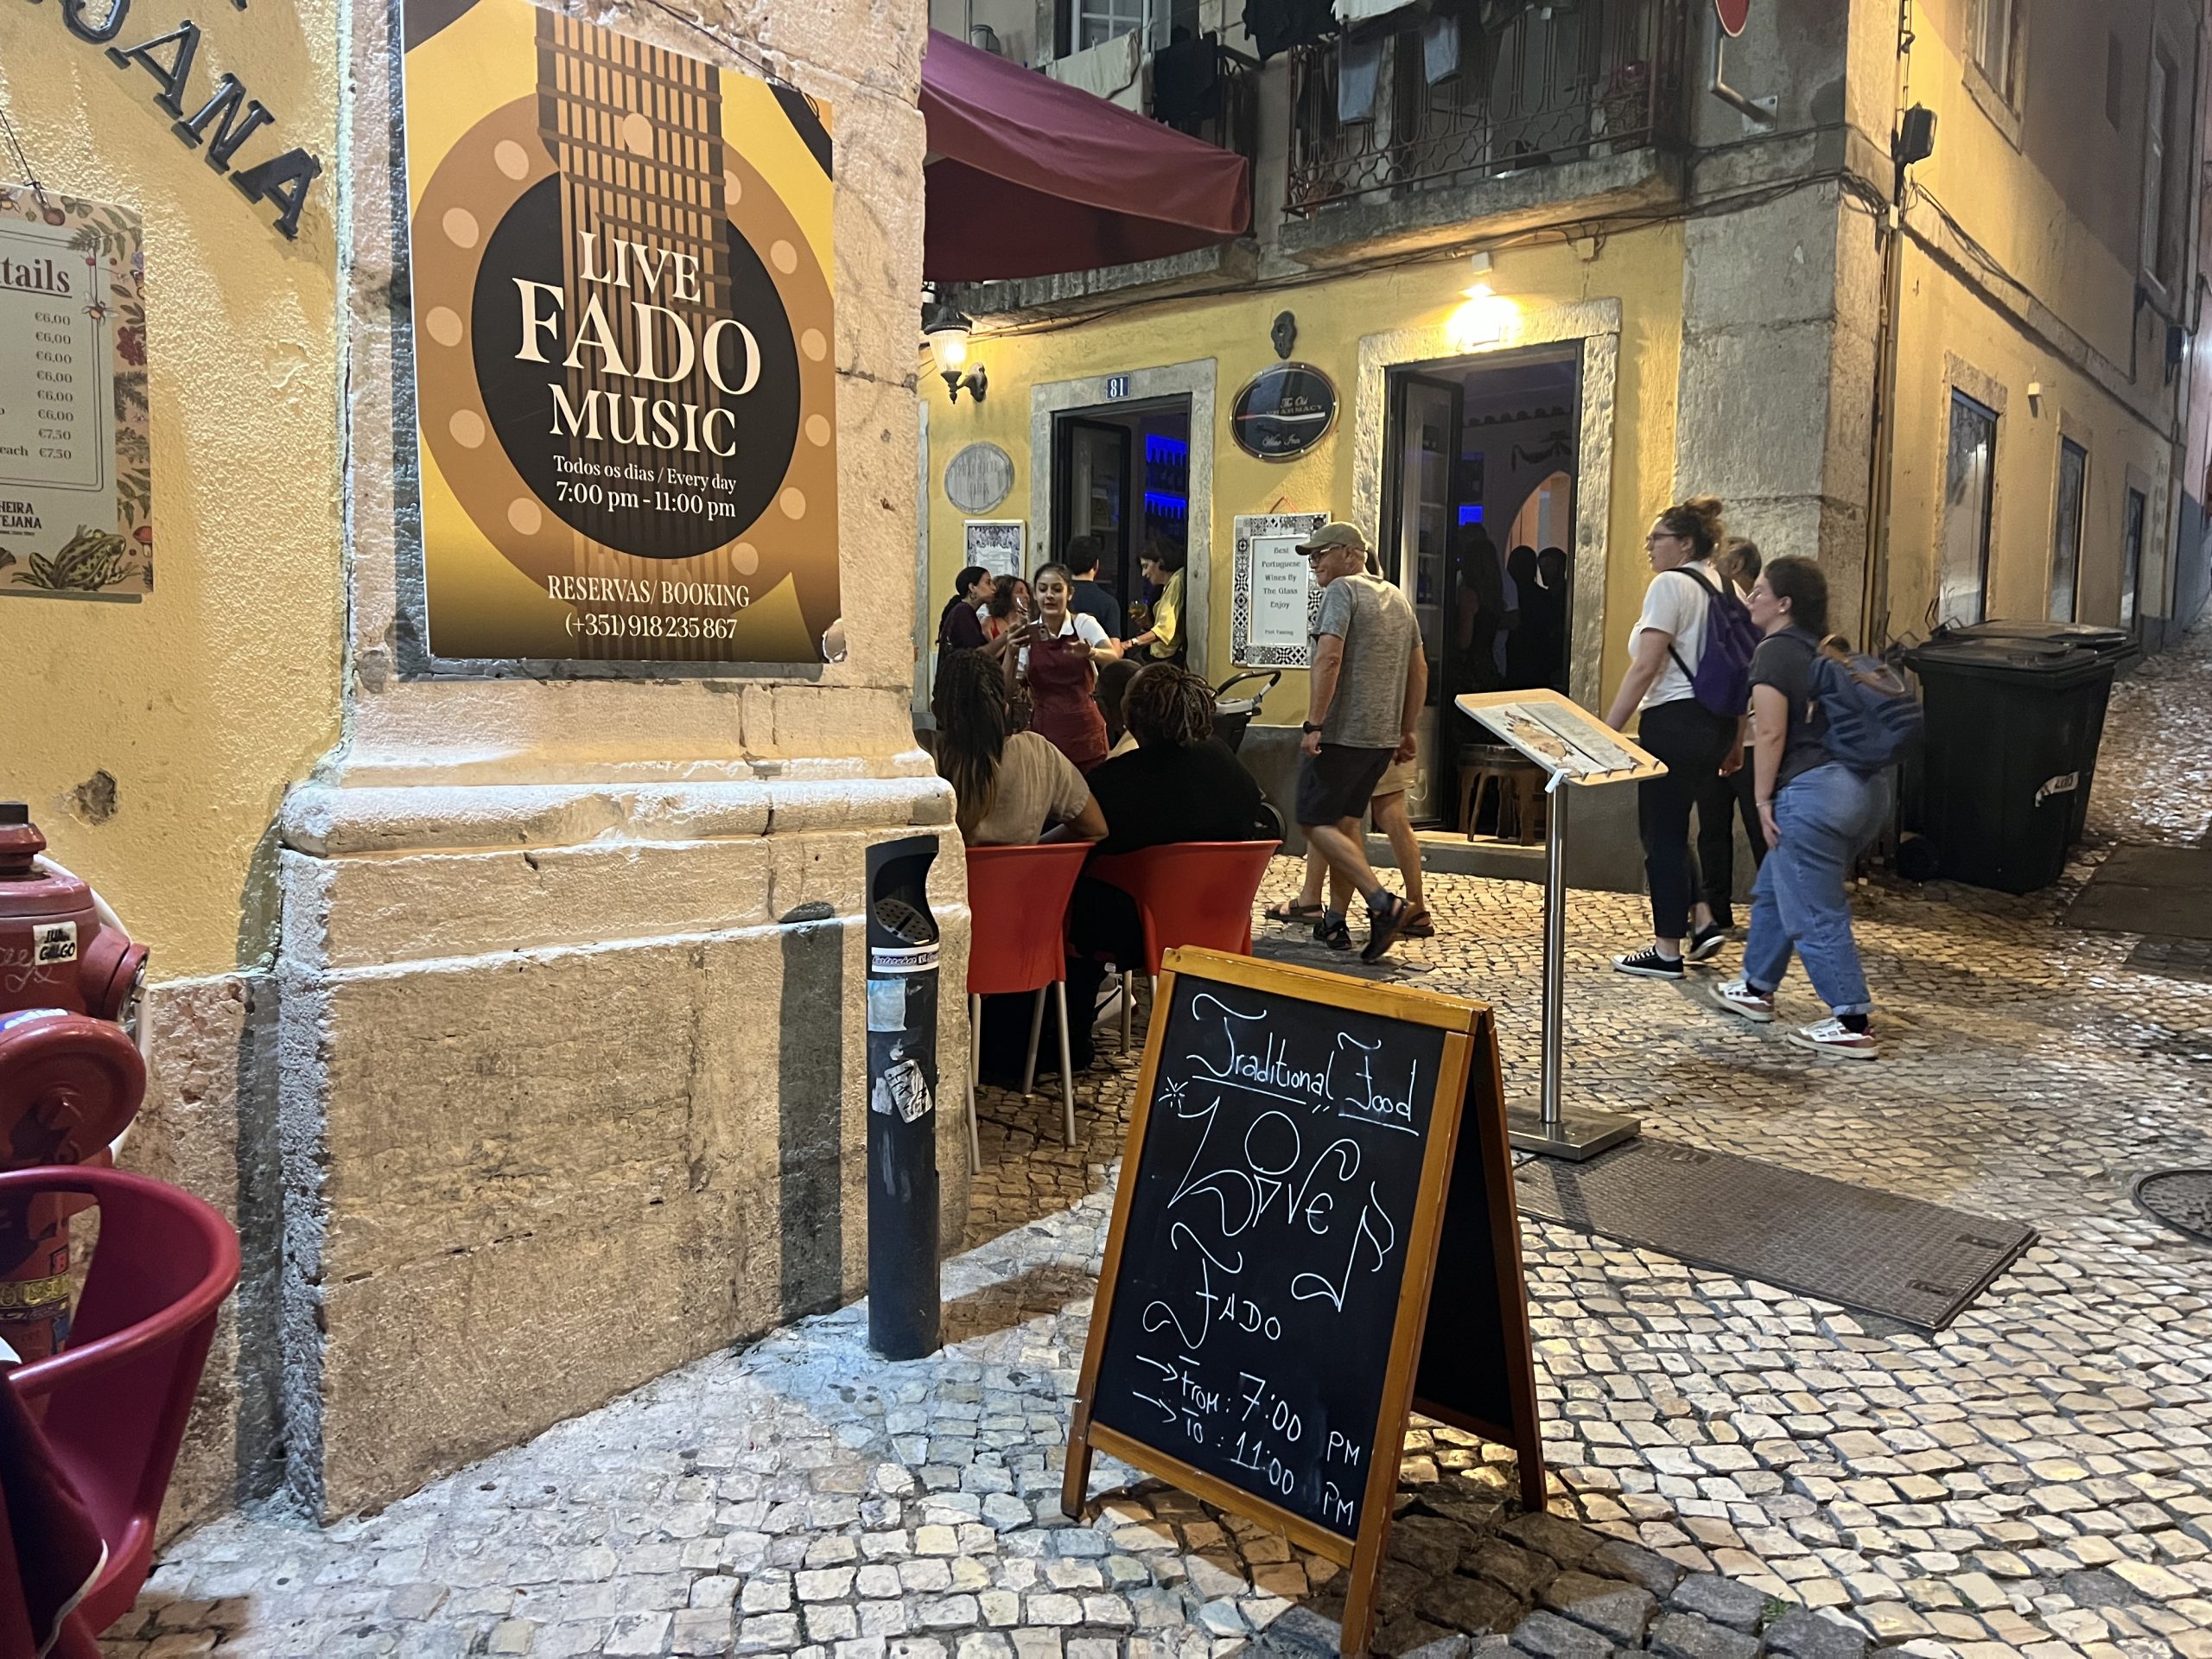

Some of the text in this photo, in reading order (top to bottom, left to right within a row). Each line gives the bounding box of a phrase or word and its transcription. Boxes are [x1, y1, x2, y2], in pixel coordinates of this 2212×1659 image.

[578, 230, 701, 302] LIVE
[0, 257, 70, 293] tails
[35, 311, 71, 326] €6.00
[35, 331, 71, 345] €6.00
[512, 277, 761, 396] FADO
[36, 351, 72, 365] €6.00
[37, 370, 73, 383] €6.00
[1110, 378, 1124, 397] 81
[37, 389, 73, 403] €6.00
[38, 408, 74, 422] €6.00
[548, 383, 735, 457] MUSIC
[38, 429, 71, 441] €7.50
[39, 447, 72, 460] €7.50
[553, 454, 736, 495] Todos os dias / Every day
[556, 480, 603, 505] 7:00
[607, 490, 639, 512] pm
[655, 491, 703, 513] 11:00
[707, 500, 736, 521] pm
[0, 515, 42, 529] EJANA
[1262, 560, 1300, 569] Portuguese
[1265, 574, 1286, 582] Wines
[661, 581, 750, 613] BOOKING
[1278, 587, 1298, 595] Glass
[1270, 601, 1290, 609] Enjoy
[565, 612, 738, 639] (+351) 918 235 867
[1186, 993, 1418, 1122] Traditional Food
[1239, 1371, 1302, 1442] 7:00
[1326, 1431, 1360, 1466] PM
[1230, 1431, 1294, 1495] 11:00
[1323, 1481, 1354, 1526] PM
